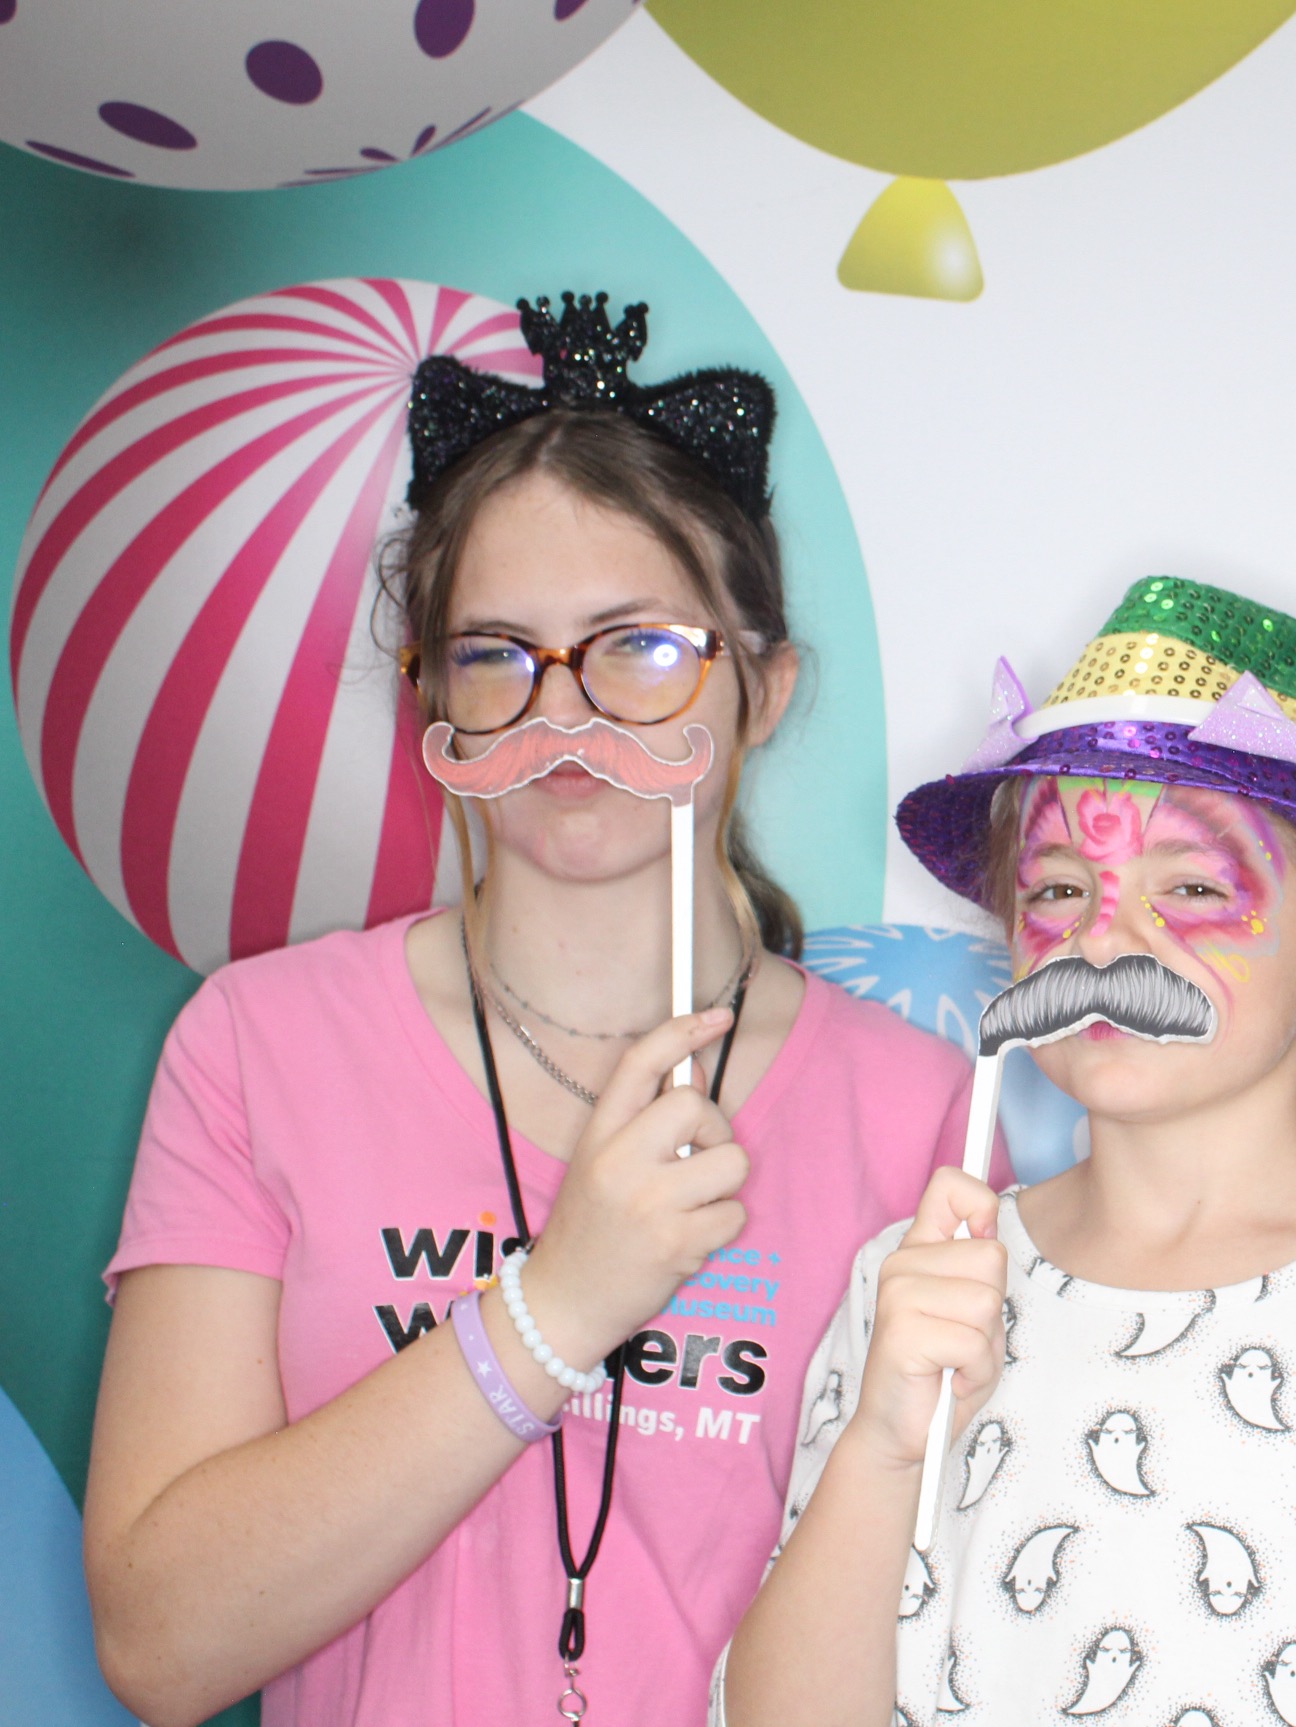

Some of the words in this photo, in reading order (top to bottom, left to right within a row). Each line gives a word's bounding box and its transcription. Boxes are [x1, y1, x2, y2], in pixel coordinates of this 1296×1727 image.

[380, 1211, 524, 1281] wi
[489, 1384, 535, 1436] STAR
[562, 1390, 685, 1441] illings,
[695, 1407, 761, 1445] MT
